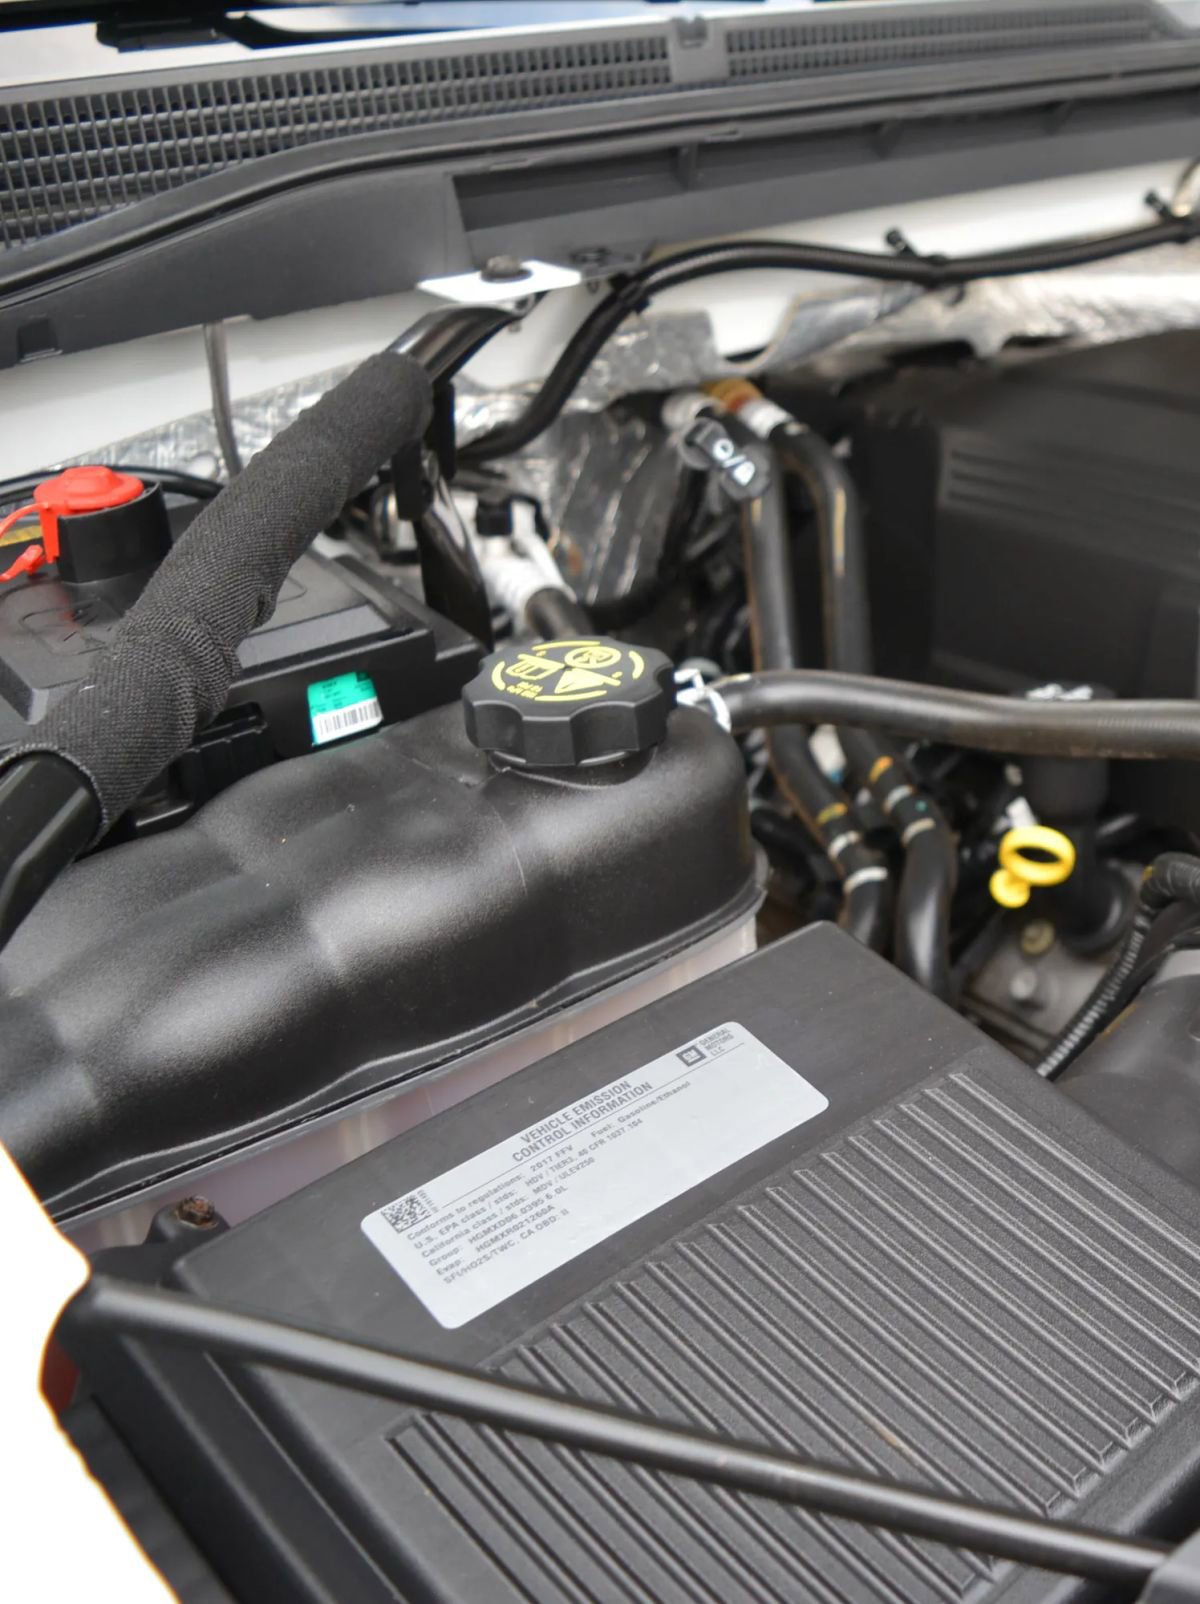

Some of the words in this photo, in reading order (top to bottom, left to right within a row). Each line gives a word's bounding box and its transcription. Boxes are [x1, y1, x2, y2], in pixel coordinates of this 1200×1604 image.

[510, 1124, 572, 1163] CONTROL
[569, 1080, 654, 1130] INFORMATION
[519, 1110, 574, 1144] VEHICLE
[571, 1079, 632, 1116] EMISSION
[405, 1210, 455, 1241] Conforms
[454, 1204, 467, 1214] to
[466, 1171, 527, 1208] regulations:
[528, 1154, 555, 1172] 2017
[553, 1143, 575, 1158] FFV
[589, 1121, 616, 1138] Fuel:
[615, 1079, 692, 1124] Gasoline/Ethanol
[412, 1232, 438, 1250] U.S.
[437, 1220, 460, 1236] EPA
[458, 1205, 487, 1224] class
[492, 1187, 518, 1205] stds:
[523, 1171, 546, 1187] HDV
[586, 1137, 607, 1151] CFR
[419, 1226, 471, 1258] California
[469, 1211, 499, 1230] class
[503, 1192, 531, 1211] stds:
[531, 1179, 555, 1195] MDV
[556, 1155, 596, 1180] ULEV250
[518, 1227, 535, 1240] CA
[533, 1212, 561, 1231] OBD:
[426, 1243, 464, 1268] Group:
[434, 1255, 465, 1276] Evap:
